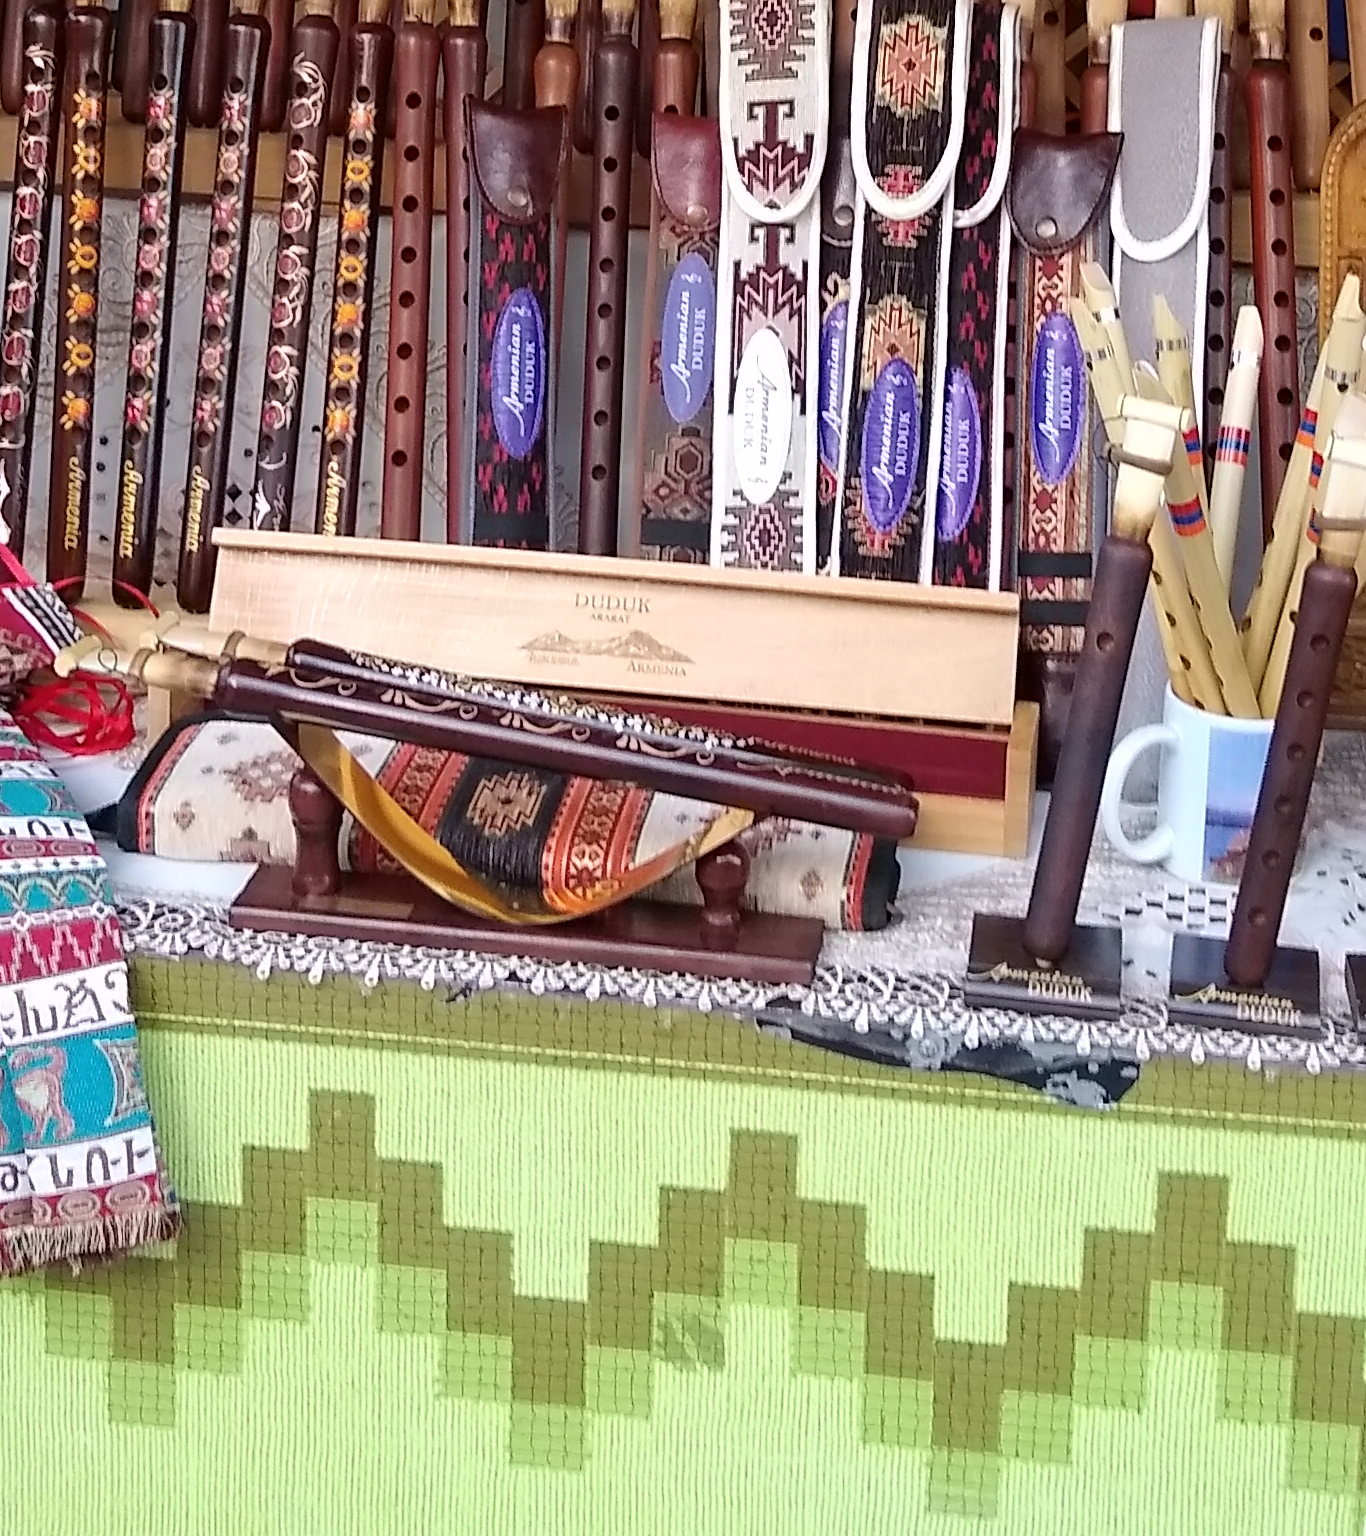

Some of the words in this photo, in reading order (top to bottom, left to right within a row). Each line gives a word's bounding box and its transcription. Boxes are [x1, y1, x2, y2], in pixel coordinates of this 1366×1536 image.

[670, 290, 691, 403] Armenian
[691, 307, 707, 370] DUDUK
[501, 321, 524, 436] Armenian
[523, 341, 538, 404] DUDUK
[822, 337, 841, 448] Armenian
[1041, 346, 1059, 462] Armenian
[1058, 366, 1074, 429] DUDUK
[743, 388, 757, 452] DUDUK
[757, 354, 777, 467] Armenian
[872, 392, 894, 504] Armenian
[894, 411, 910, 475] DUDUK
[954, 419, 971, 482] DUDUK
[64, 455, 87, 551] Armenia
[119, 459, 143, 559] Armenia
[187, 465, 211, 553] Armenia
[323, 462, 347, 536] Armen
[574, 592, 651, 614] DUDUK
[590, 614, 630, 624] ARARAT
[627, 660, 687, 677] ARMENIA
[968, 962, 1084, 986] Armenian
[1027, 980, 1093, 1004] DUDUK
[1175, 983, 1293, 1009] Armenian
[1235, 1002, 1301, 1025] DUDUK
